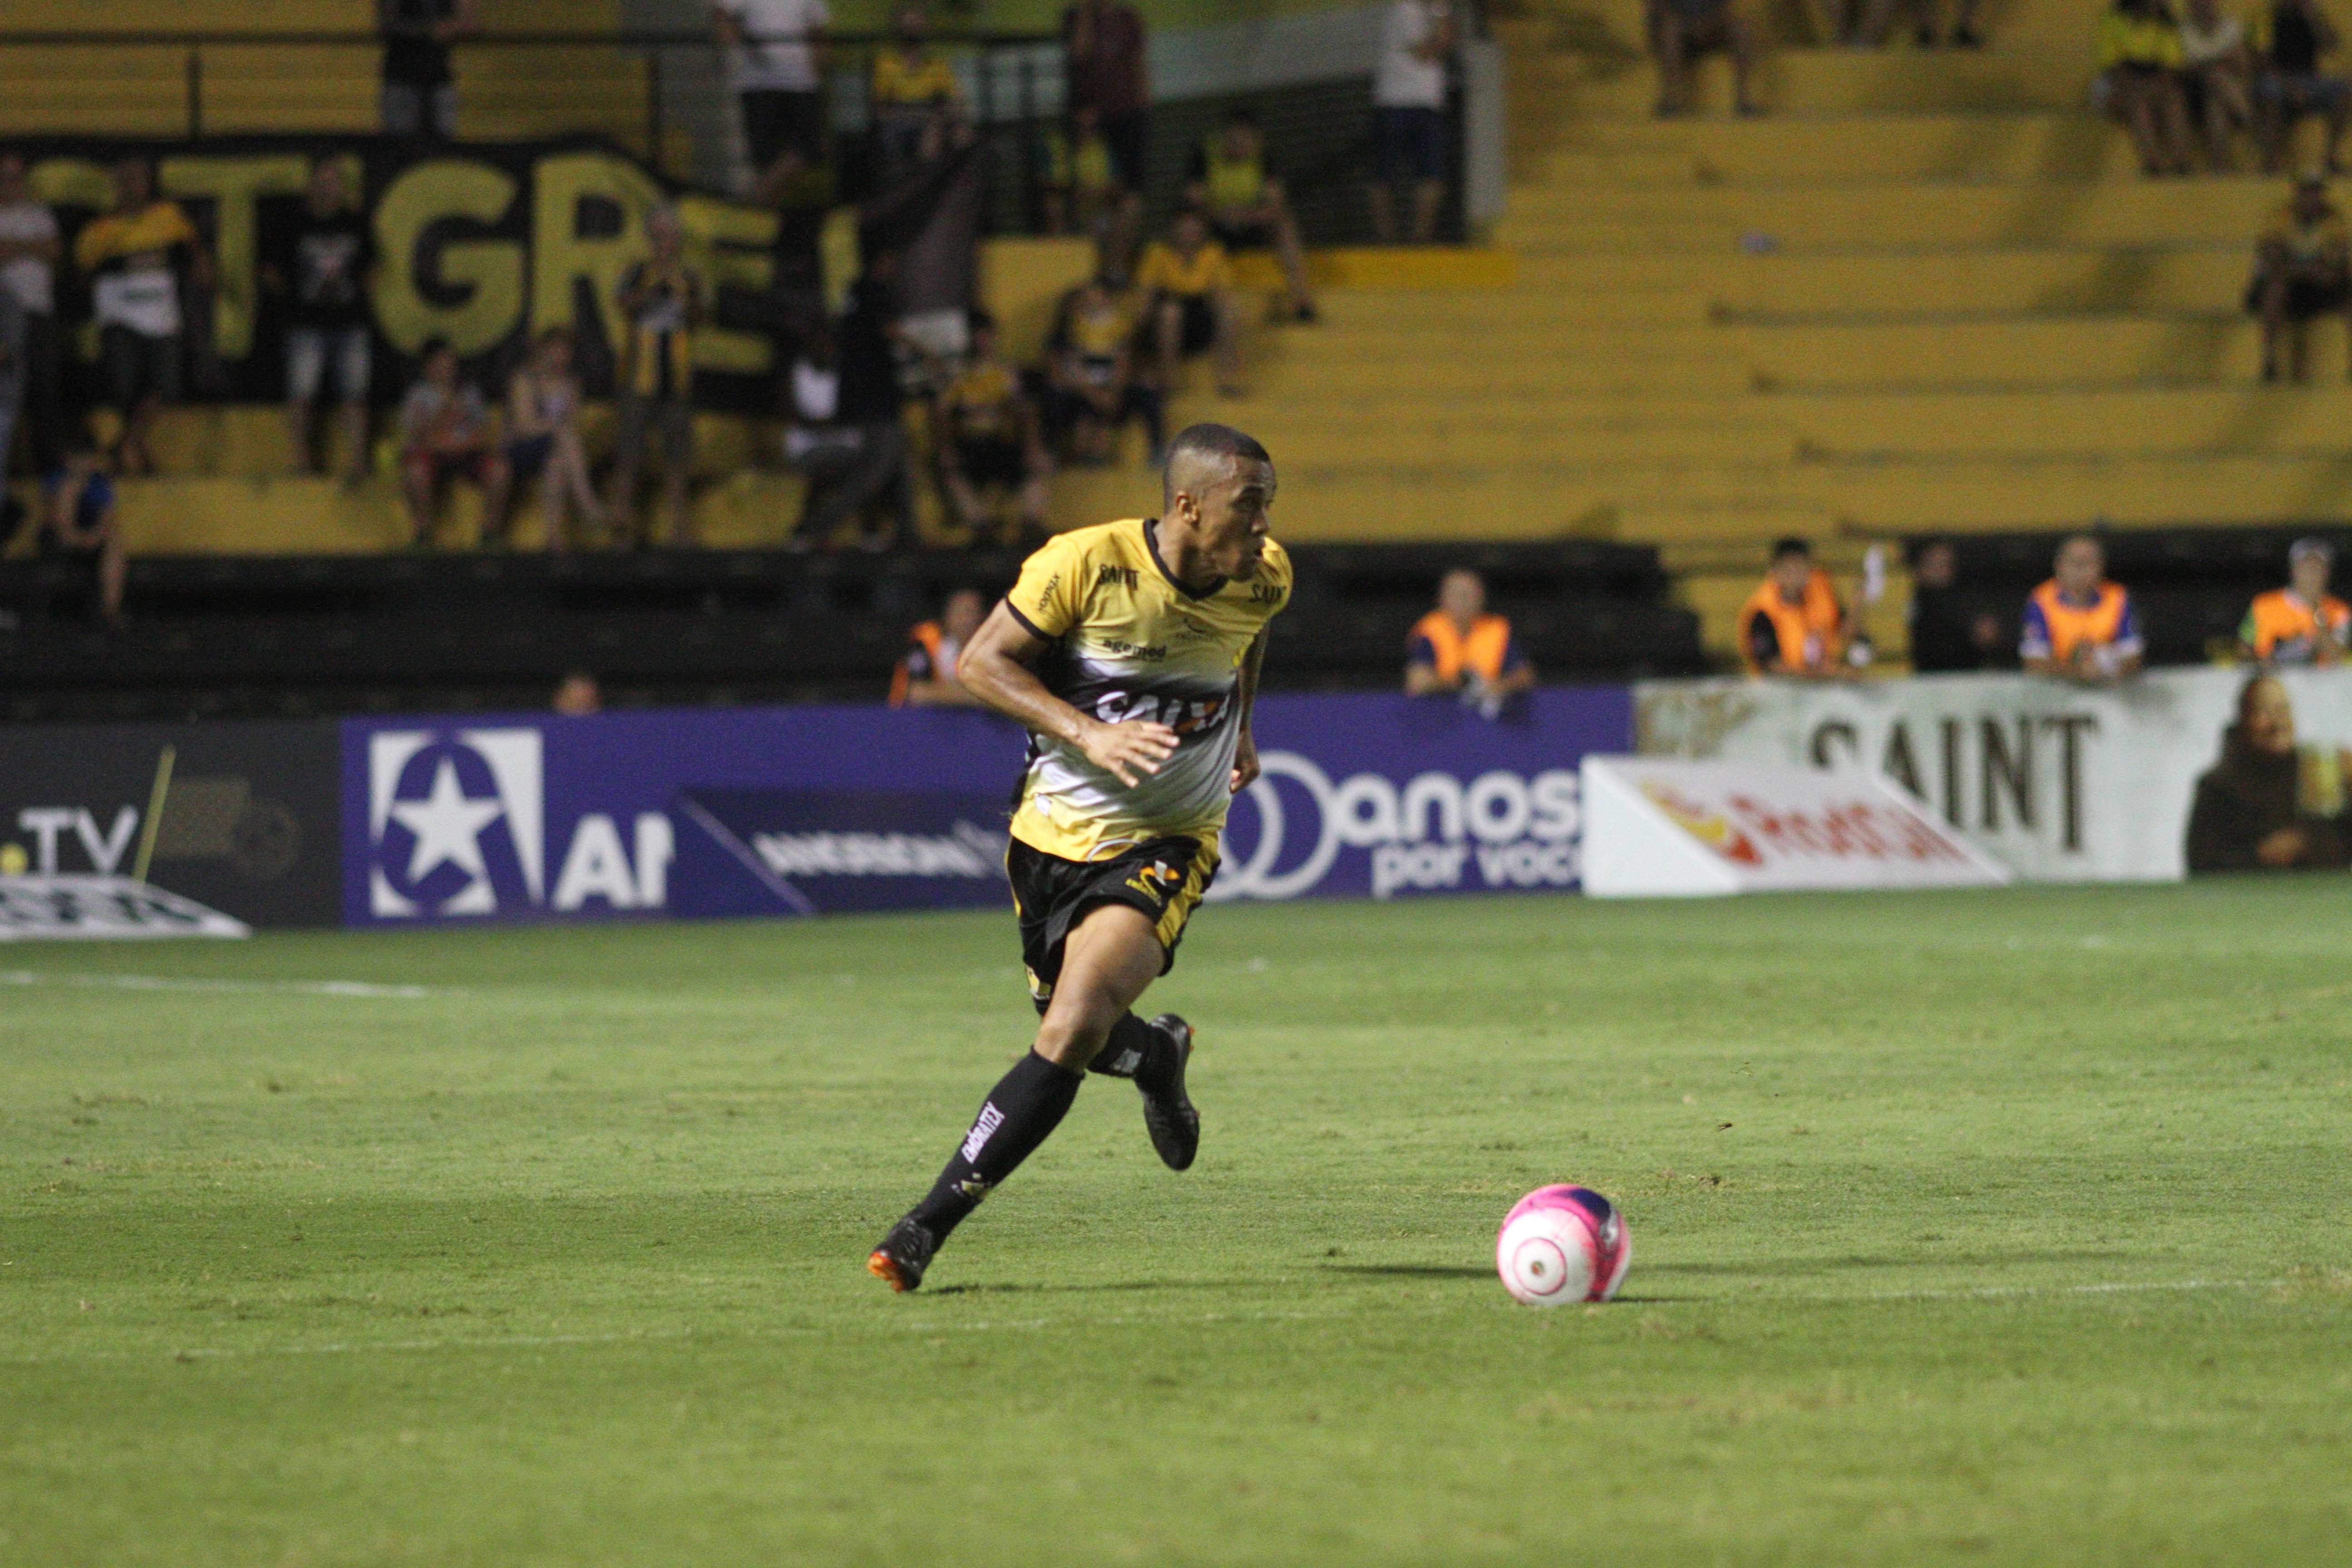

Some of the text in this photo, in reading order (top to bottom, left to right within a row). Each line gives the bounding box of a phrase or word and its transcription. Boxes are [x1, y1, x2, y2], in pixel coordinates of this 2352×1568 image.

[17, 803, 140, 875] TV
[1370, 842, 1583, 902] por voc
